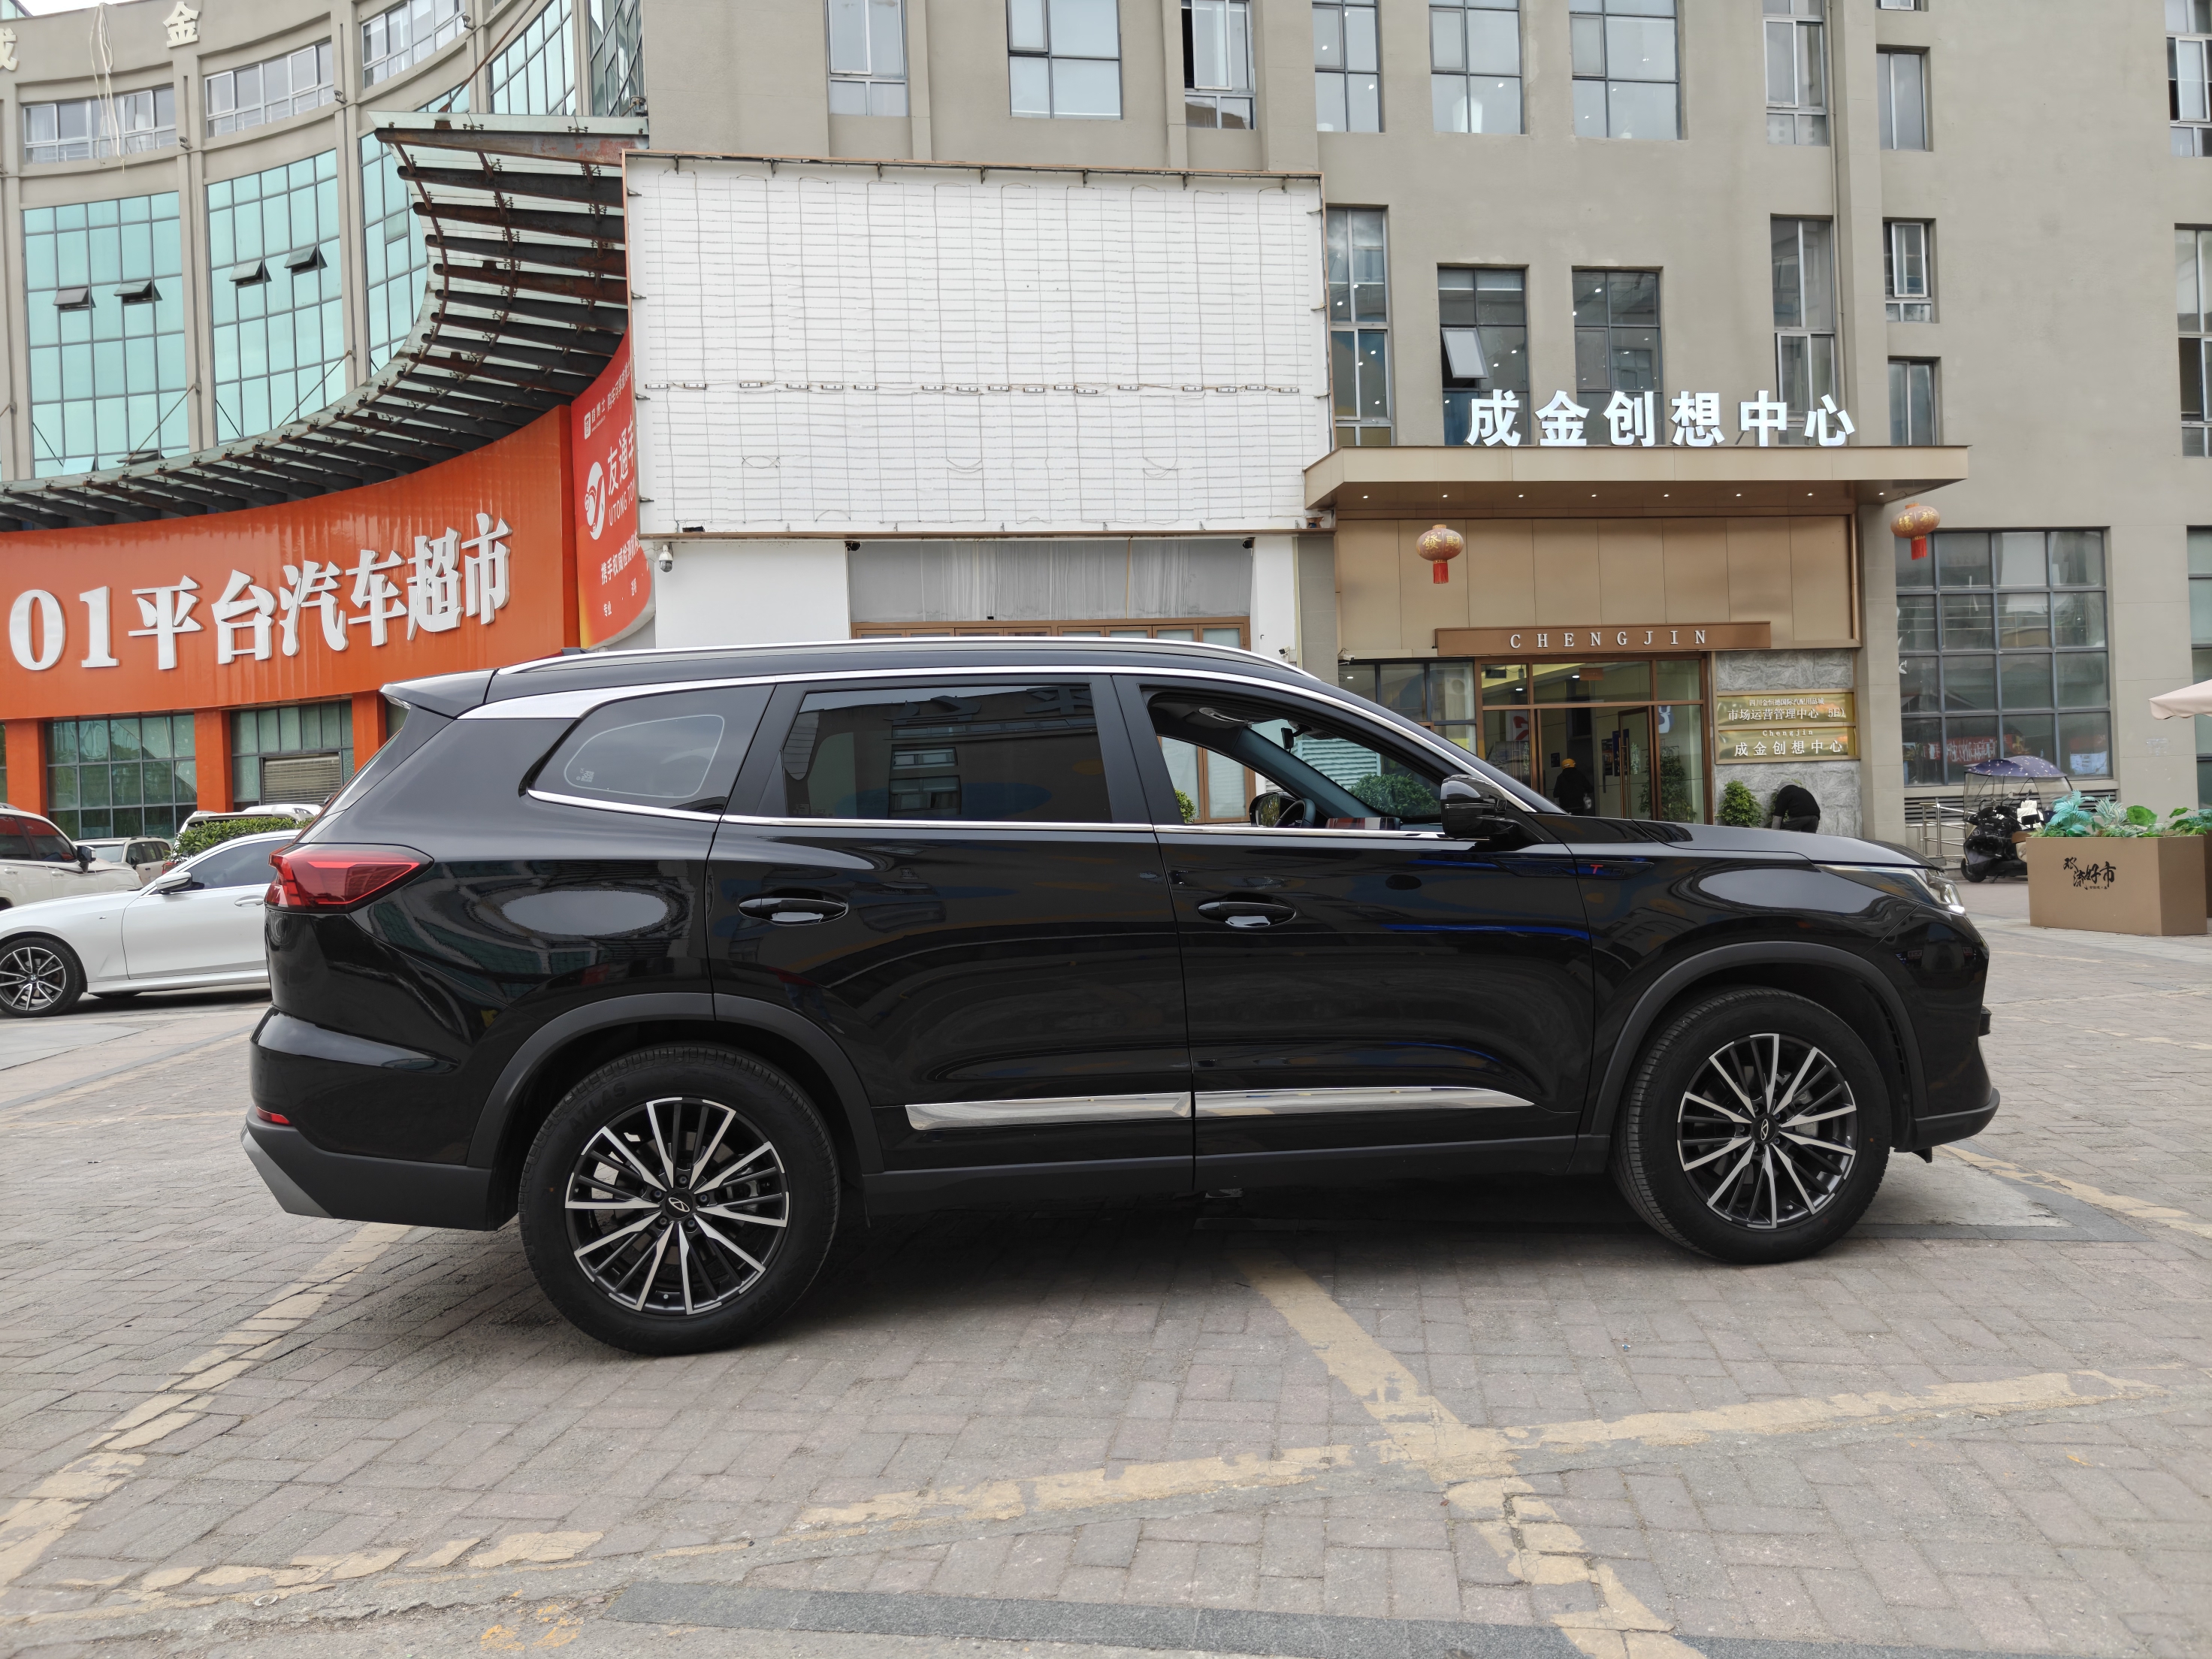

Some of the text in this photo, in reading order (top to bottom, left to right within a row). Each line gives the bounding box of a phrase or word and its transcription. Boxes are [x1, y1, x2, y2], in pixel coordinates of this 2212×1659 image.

[163, 2, 199, 48] 金
[1464, 388, 1856, 448] 成金创想中心
[609, 491, 627, 527] UTONG
[1509, 630, 1706, 648] CHENGJIN
[1749, 697, 1824, 706] 四川金恒德国际汽配用品城
[1727, 709, 1819, 721] 市场运营管理中心
[1763, 729, 1813, 737] Chengjin
[1734, 739, 1843, 757] 成金创想中心
